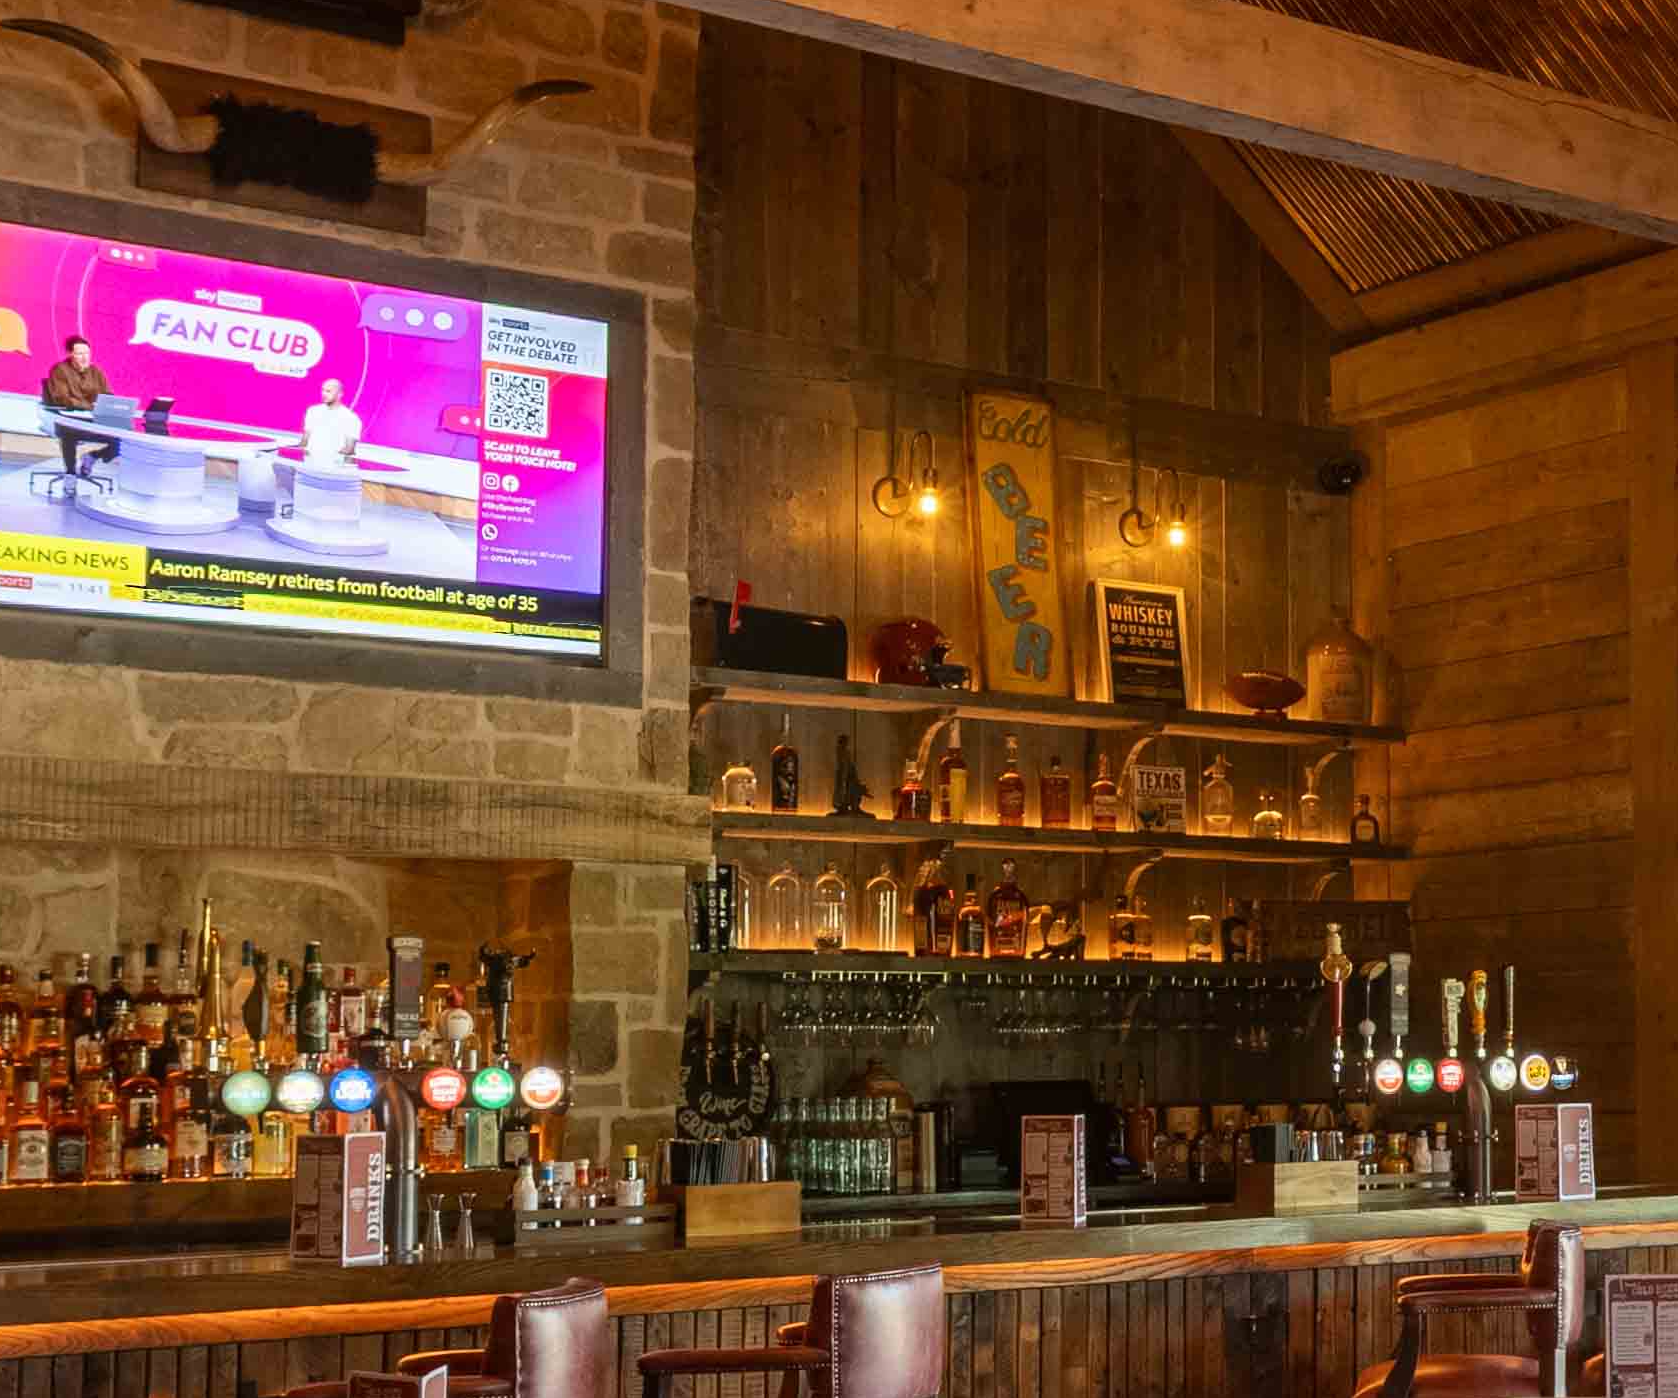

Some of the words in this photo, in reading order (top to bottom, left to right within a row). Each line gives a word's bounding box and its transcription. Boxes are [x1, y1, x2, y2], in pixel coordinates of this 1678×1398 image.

[152, 313, 217, 343] FAN
[227, 326, 309, 357] CLUB
[488, 331, 510, 342] GET
[514, 335, 576, 352] INVOLVED
[488, 342, 500, 351] IN
[504, 345, 526, 357] THE
[529, 348, 578, 364] DEBATE!
[979, 401, 1049, 449] Cold
[484, 441, 514, 452] SCAN
[515, 445, 530, 454] TO
[530, 447, 561, 459] LEAVE
[484, 452, 514, 463] YOUR
[515, 455, 546, 468] VOICE
[74, 553, 130, 571] NEWS
[981, 462, 1052, 682] BEER
[150, 559, 205, 580] Aaron
[208, 564, 277, 589] Ramsey
[279, 573, 335, 592] retires
[336, 577, 377, 596] from
[380, 582, 444, 604] football
[446, 592, 464, 605] at
[466, 593, 495, 611] age
[498, 594, 516, 610] of
[518, 595, 539, 612] 35
[1108, 602, 1173, 626] WHISKEY
[1110, 623, 1175, 638] BOURBON
[1128, 636, 1175, 650] RYE
[1137, 771, 1181, 790] TEXAS
[335, 1088, 372, 1100] LIGHT
[367, 1153, 381, 1242] DRINKS
